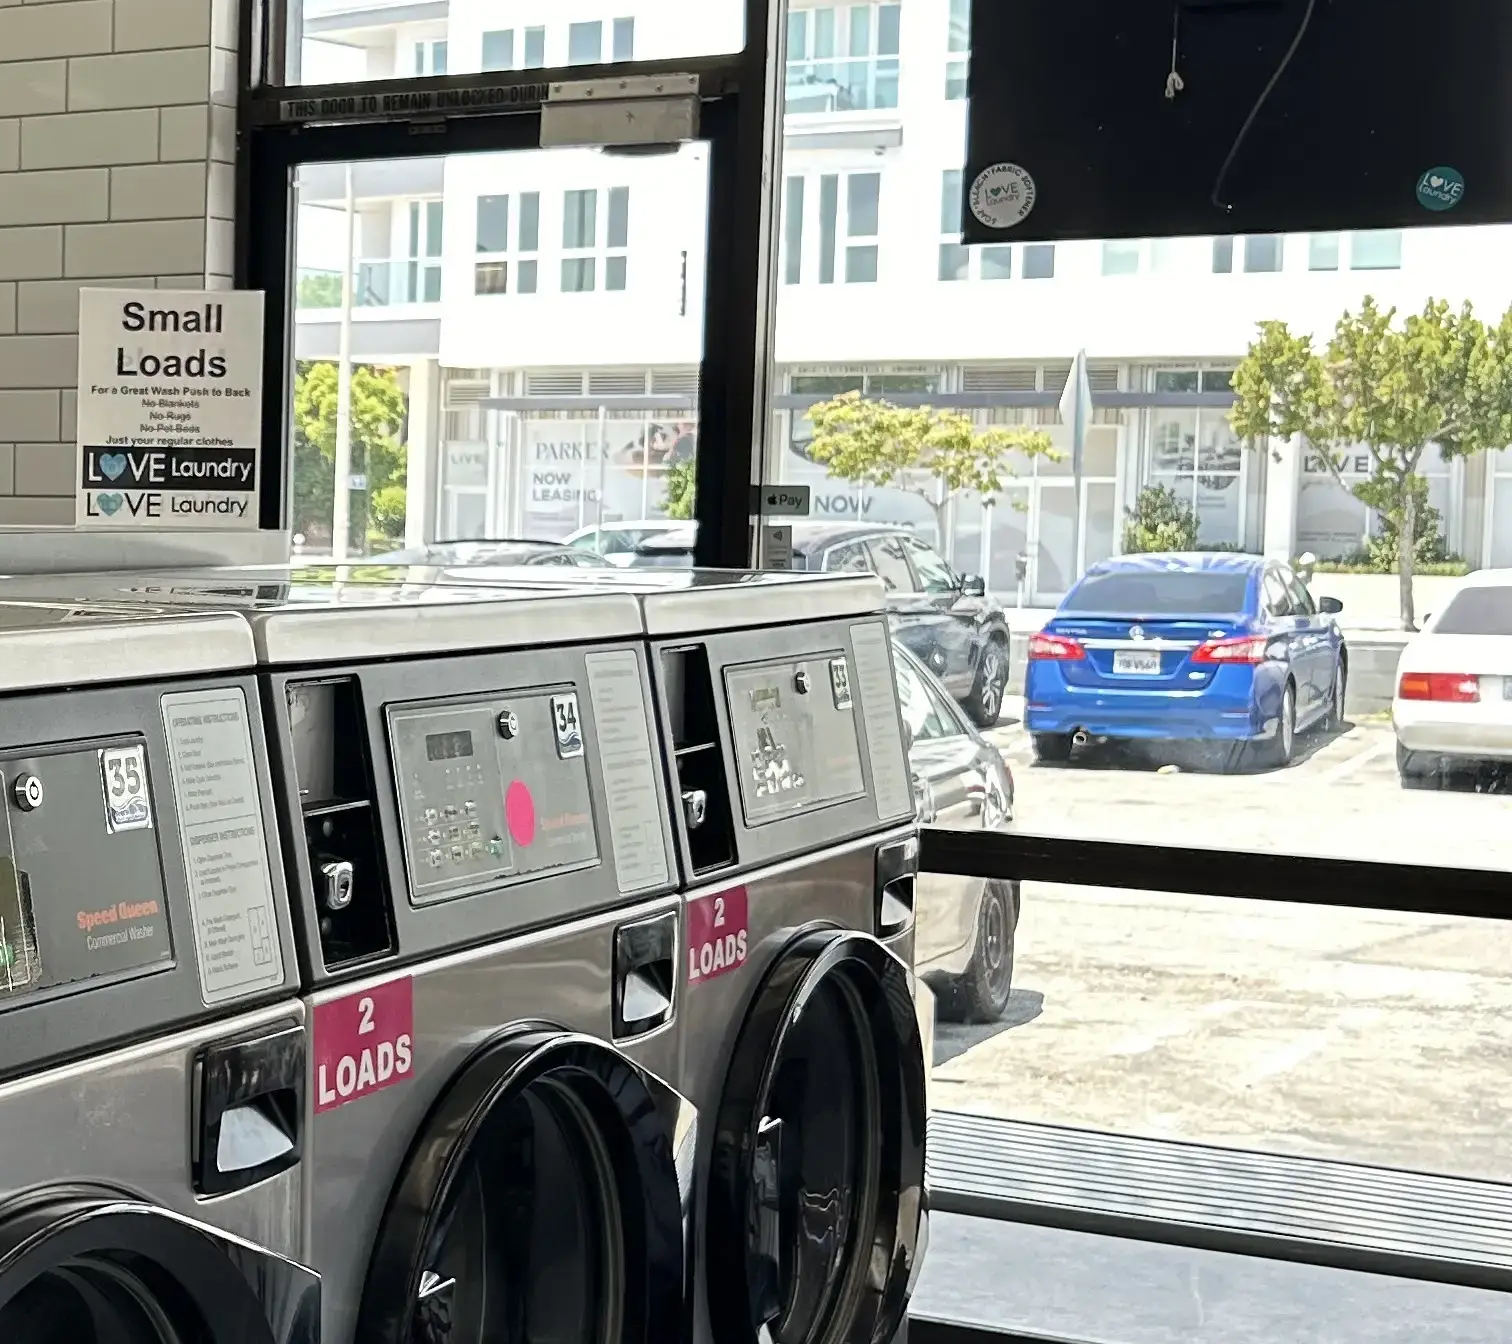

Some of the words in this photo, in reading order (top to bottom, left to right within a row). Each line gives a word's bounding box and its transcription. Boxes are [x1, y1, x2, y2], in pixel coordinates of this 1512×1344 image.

[288, 100, 316, 118] THIS
[321, 98, 355, 115] DOOR
[359, 97, 377, 114] TO
[384, 92, 430, 112] REMAIN
[438, 87, 504, 108] UNLOCKED
[510, 83, 548, 104] DURIN
[122, 302, 223, 333] Small
[117, 347, 227, 378] Loads
[91, 386, 109, 395] For
[120, 386, 149, 396] Great
[151, 387, 180, 396] Wash
[183, 387, 209, 396] Push
[212, 388, 222, 397] to
[225, 388, 251, 397] Back
[141, 399, 156, 407] No
[140, 424, 154, 433] No
[149, 412, 164, 420] No
[106, 435, 128, 444] Just
[131, 437, 155, 447] your
[157, 436, 193, 446] regular
[196, 437, 234, 446] clothes
[171, 457, 252, 482] Laundry
[1304, 455, 1369, 473] LVE
[533, 472, 572, 485] NOW
[171, 496, 249, 518] Laundry
[532, 489, 598, 502] LEASING
[779, 494, 803, 509] Pay
[814, 494, 873, 514] NOW
[556, 702, 577, 732] 34
[108, 756, 141, 797] 35
[76, 904, 117, 931] Speed
[118, 899, 158, 920] Queen
[714, 897, 725, 928] 2
[87, 928, 129, 951] Commercial
[129, 923, 154, 941] Washer
[689, 929, 747, 980] LOADS
[358, 997, 375, 1035] 2
[319, 1034, 412, 1105] LOADS
